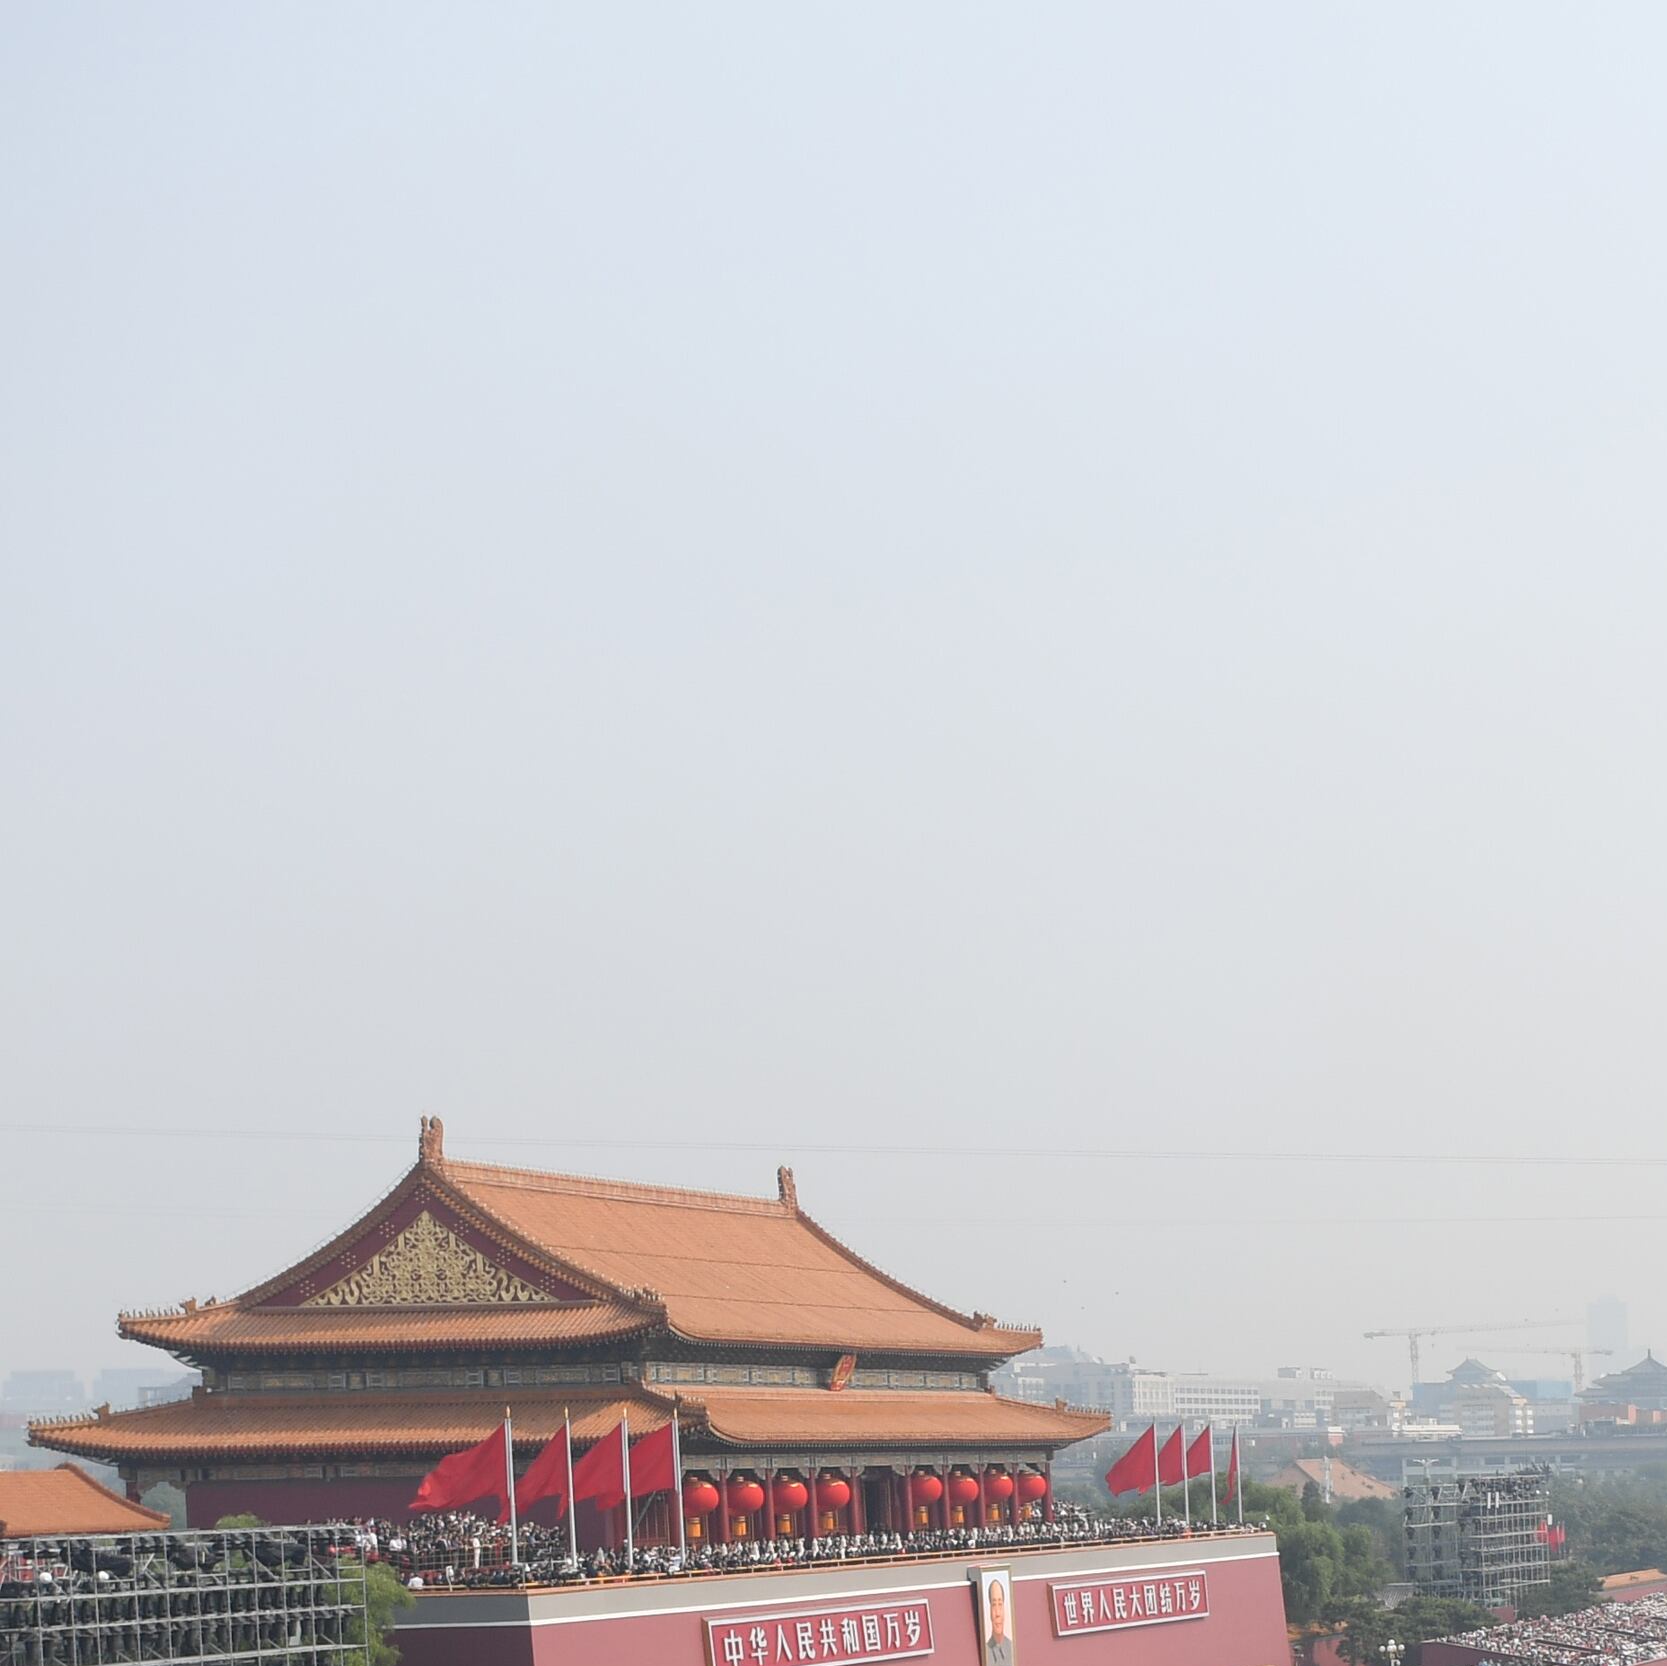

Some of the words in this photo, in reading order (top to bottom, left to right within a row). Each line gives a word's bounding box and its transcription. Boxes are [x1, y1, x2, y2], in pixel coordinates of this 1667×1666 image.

[1063, 1579, 1201, 1626] 世界人民大团结万岁
